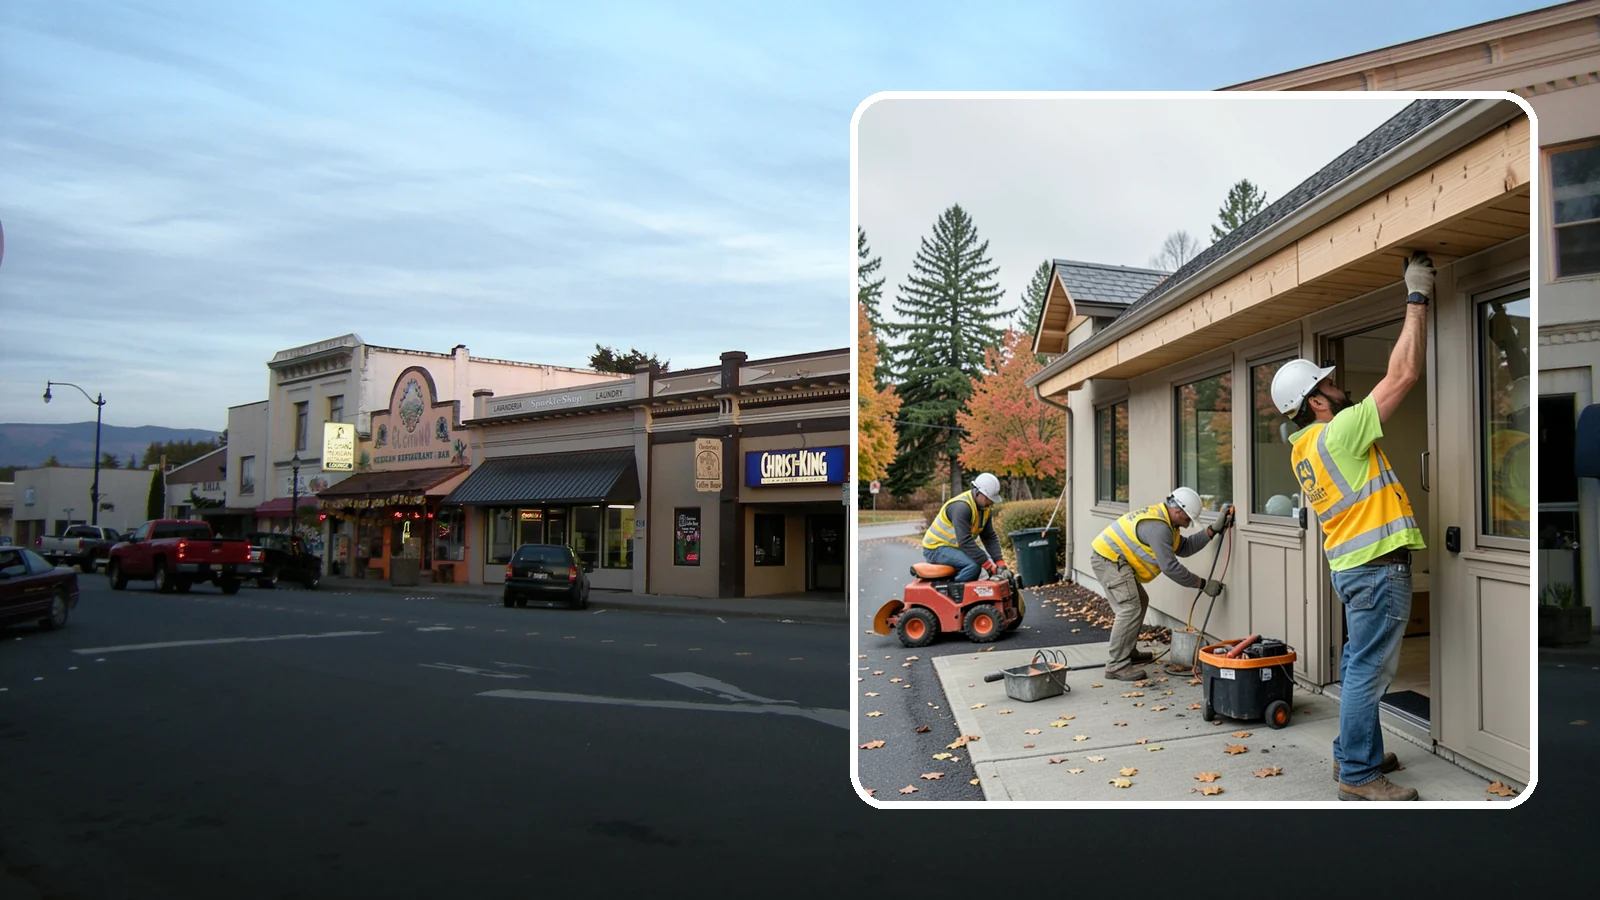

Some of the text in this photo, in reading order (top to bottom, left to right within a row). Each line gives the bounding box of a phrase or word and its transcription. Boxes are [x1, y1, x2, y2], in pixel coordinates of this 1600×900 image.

[562, 394, 582, 405] Shop
[595, 388, 623, 400] LAUNDRY
[493, 402, 522, 413] LAVANDERIA
[373, 450, 450, 464] MEXICAN RESTAURANT BAR
[761, 450, 827, 478] CHRIST KING
[697, 480, 709, 489] Coffee
